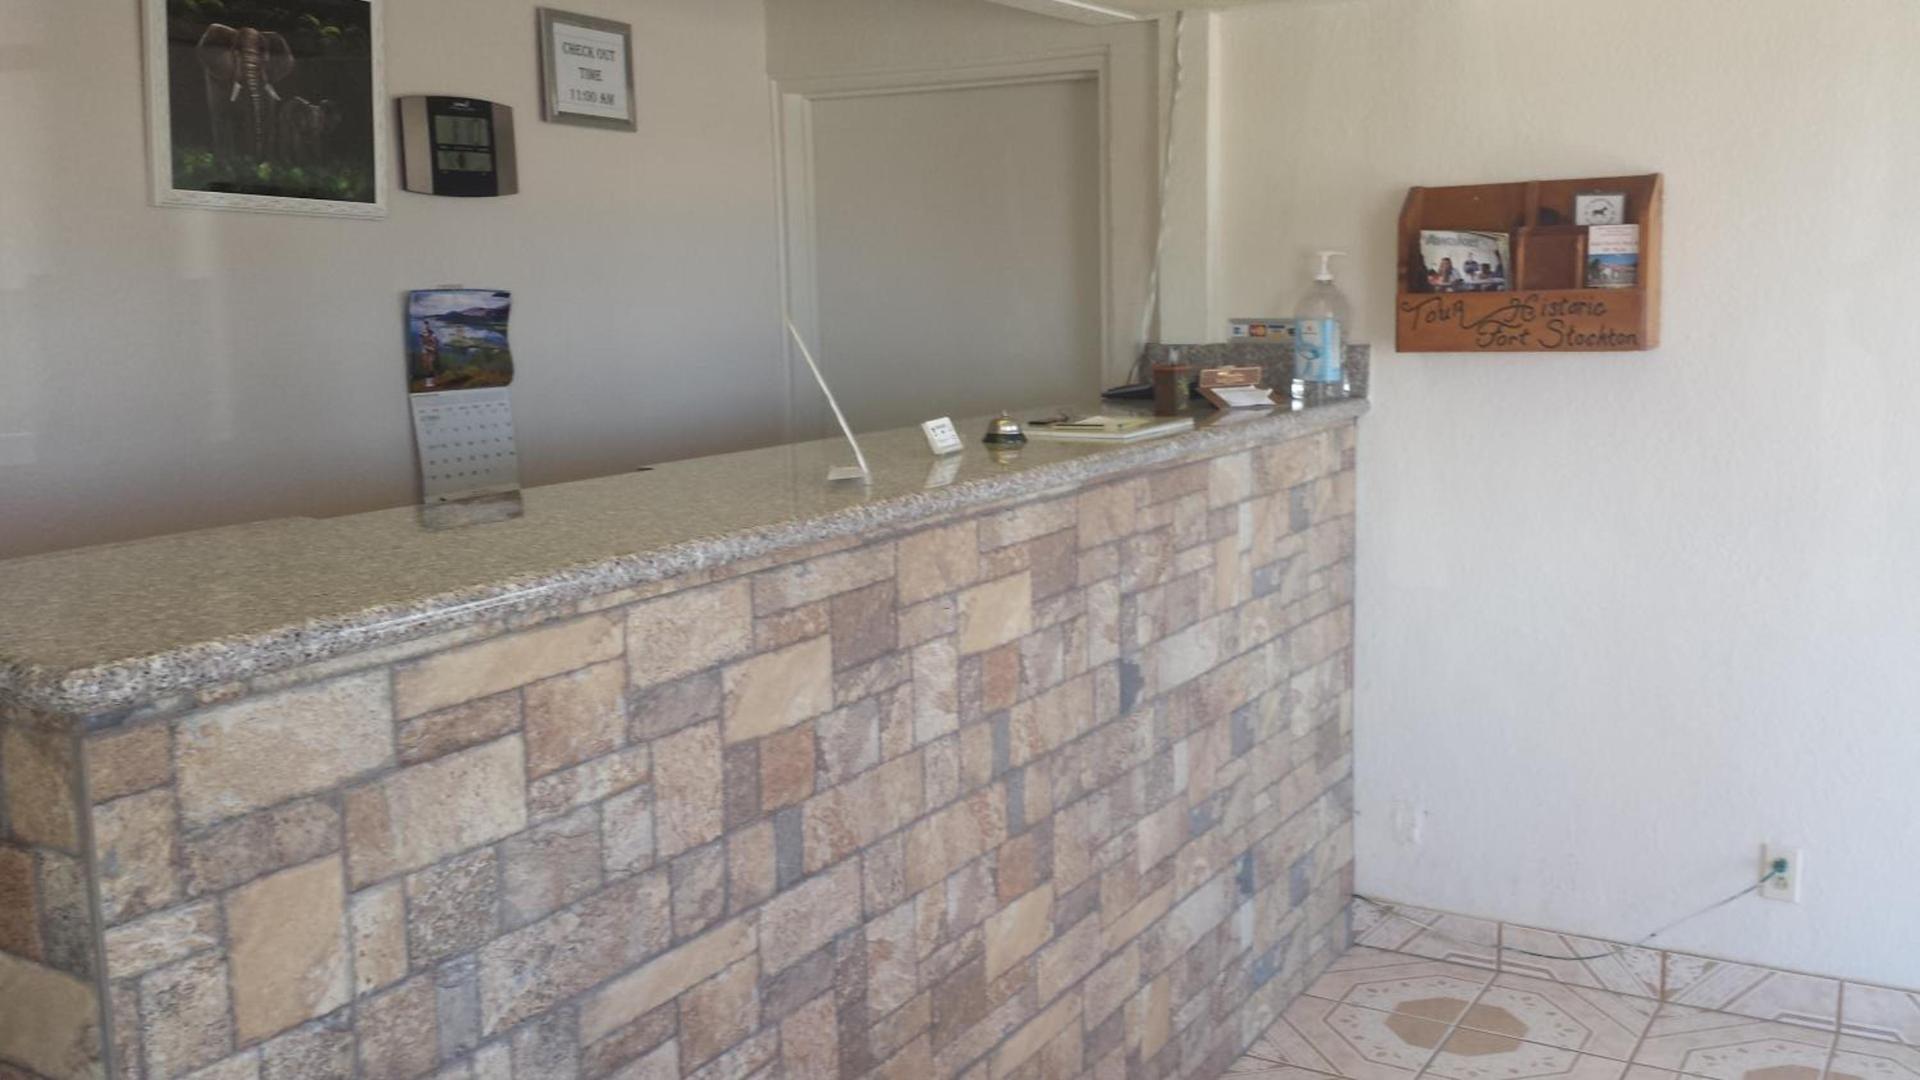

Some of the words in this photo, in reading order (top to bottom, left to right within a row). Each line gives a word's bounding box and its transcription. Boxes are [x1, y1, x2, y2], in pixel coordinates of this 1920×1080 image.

[562, 41, 595, 59] CHECK
[597, 48, 615, 61] OUT
[578, 66, 603, 81] TIME
[599, 93, 615, 105] AM
[1475, 319, 1531, 348] Fort
[1537, 319, 1639, 349] Stockton
